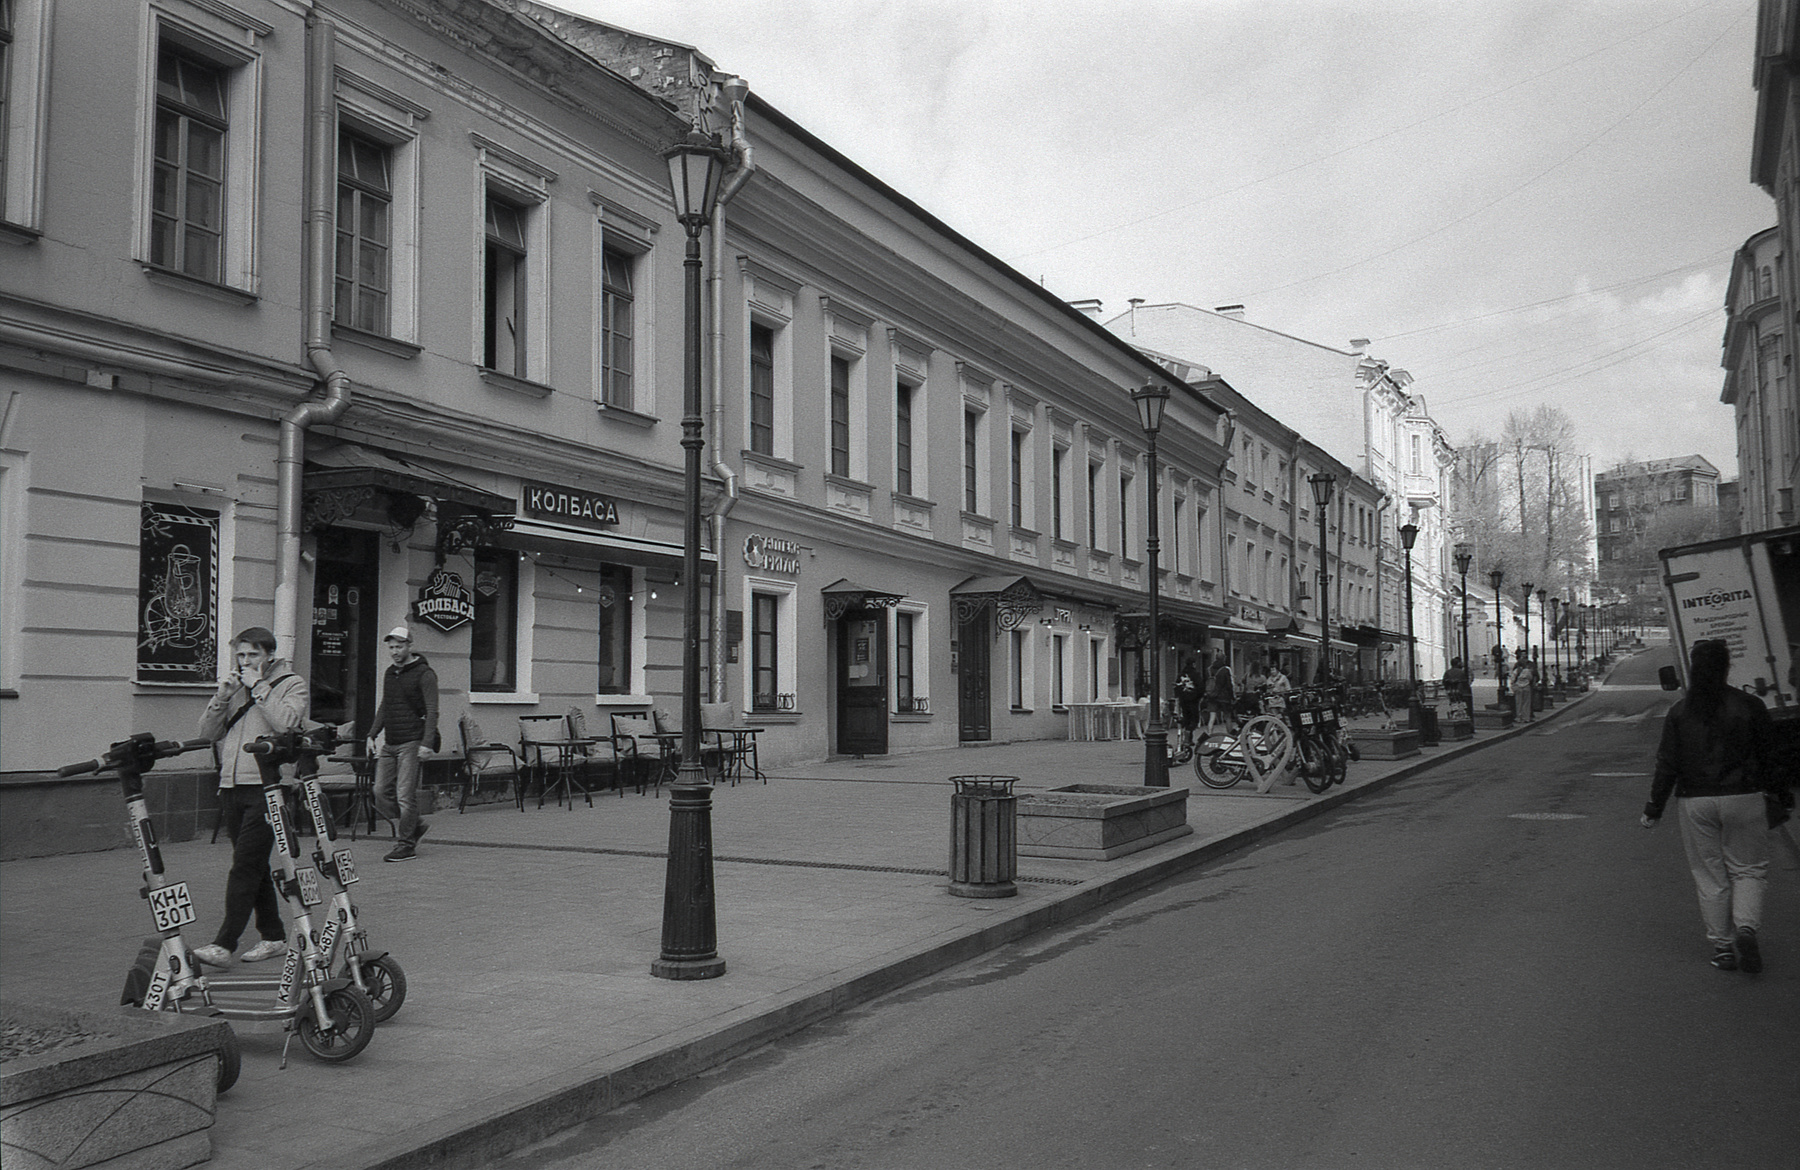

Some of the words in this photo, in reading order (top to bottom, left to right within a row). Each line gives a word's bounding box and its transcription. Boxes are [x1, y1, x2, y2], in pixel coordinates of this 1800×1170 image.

[531, 488, 617, 523] КОЛБАСА
[763, 537, 800, 555] АПТЕКА
[417, 597, 476, 621] КОЛБАСА
[1682, 589, 1752, 609] INTEGRITA
[433, 613, 460, 621] РЕСТОБАР
[306, 781, 327, 835] WHOOSH
[268, 794, 288, 854] WHOOSH
[151, 886, 189, 911] KH4
[159, 903, 192, 928] 30T
[320, 920, 338, 956] 487M
